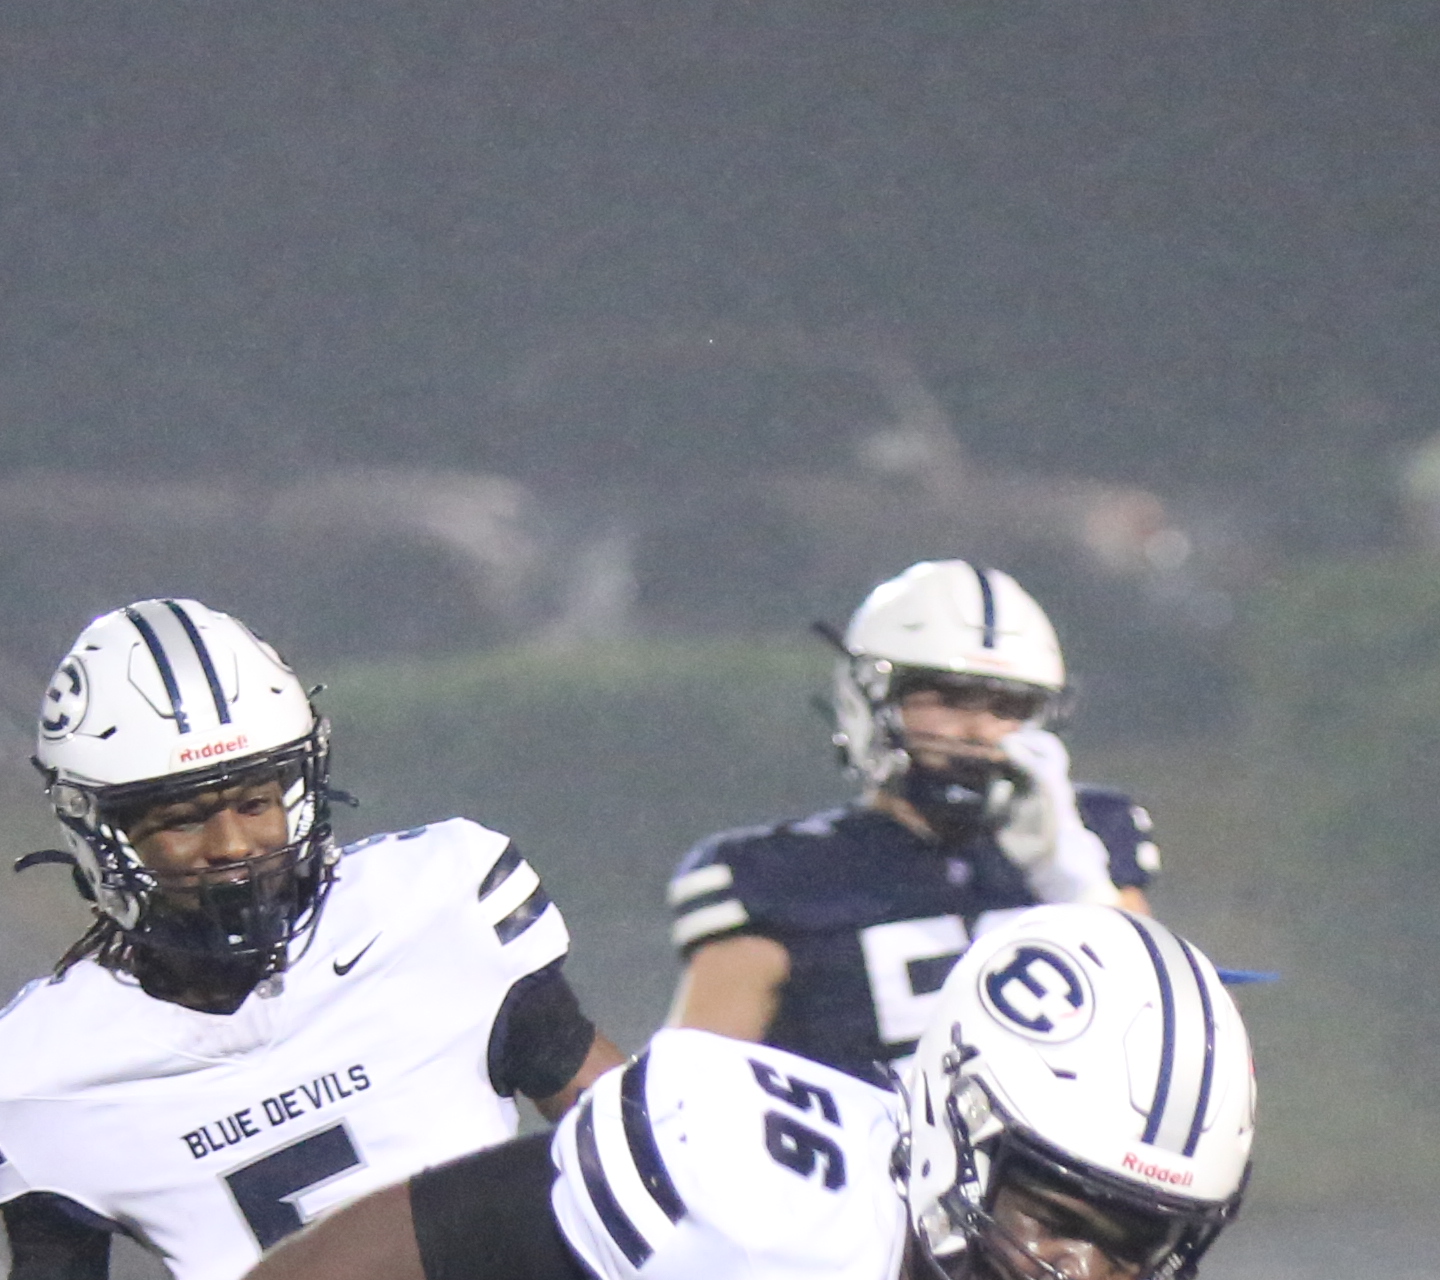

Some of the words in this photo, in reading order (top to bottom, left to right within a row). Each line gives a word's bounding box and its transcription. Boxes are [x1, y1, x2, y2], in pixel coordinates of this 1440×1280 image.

[985, 946, 1084, 1033] E
[180, 1107, 262, 1160] BLUE
[261, 1064, 372, 1127] DEVILS
[747, 1057, 847, 1191] 56
[1121, 1151, 1195, 1187] Riddell
